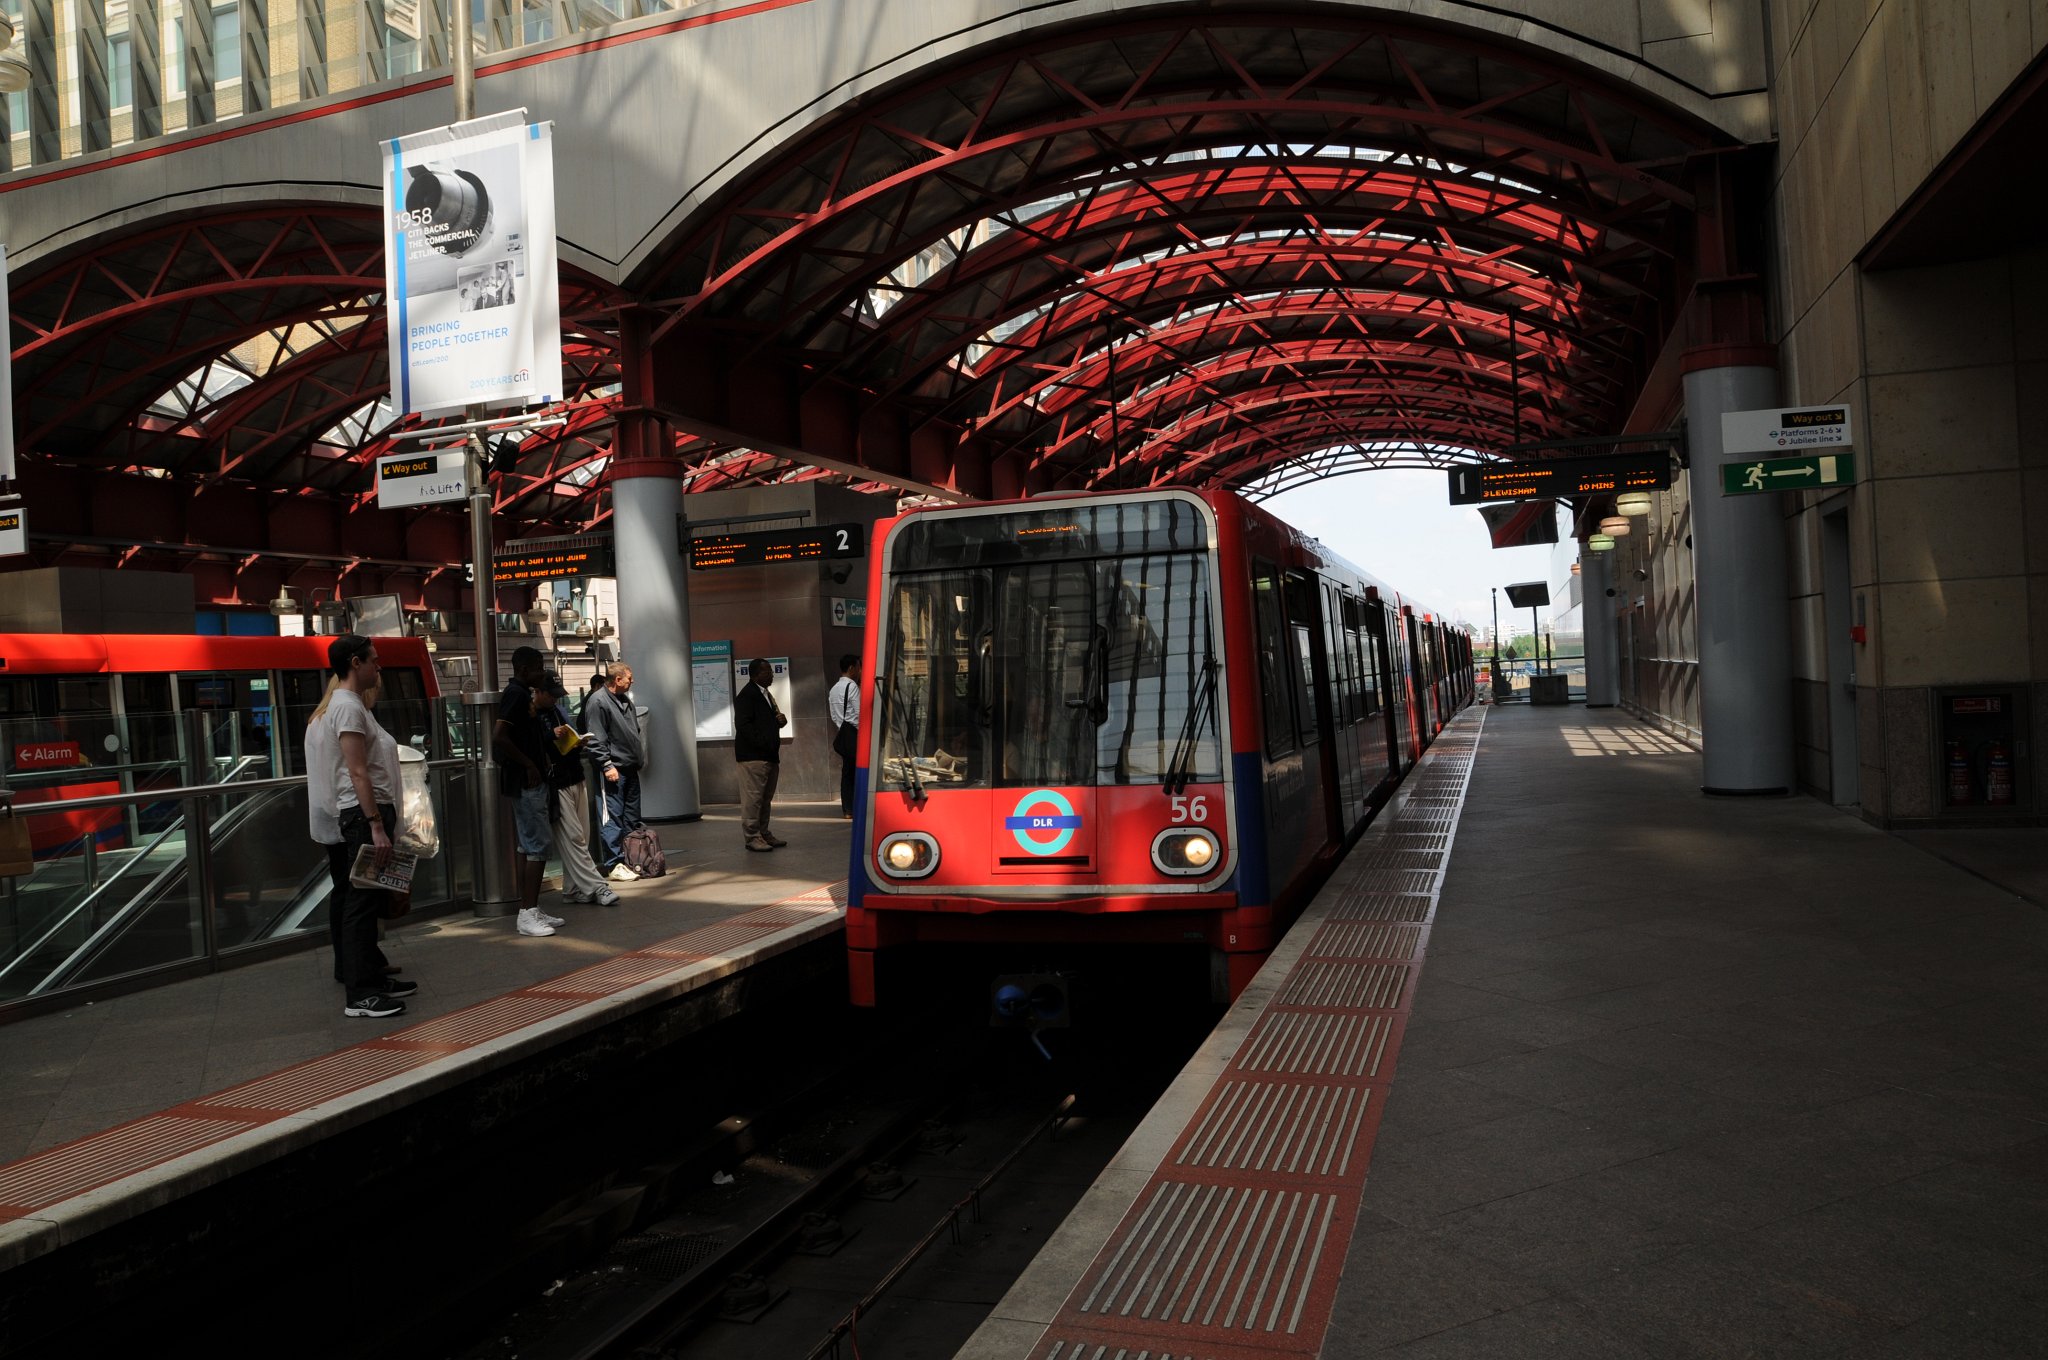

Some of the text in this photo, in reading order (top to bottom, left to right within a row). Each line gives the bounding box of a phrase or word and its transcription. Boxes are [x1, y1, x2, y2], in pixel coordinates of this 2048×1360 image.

[395, 207, 432, 230] 1958
[408, 223, 449, 238] CITI BACKS
[408, 228, 475, 248] THE COMMERCIAL
[408, 246, 448, 261] JETLINER.
[411, 320, 460, 337] BRINGING
[412, 327, 508, 352] PEOPLE TOGETHER
[514, 372, 528, 382] citi
[1792, 413, 1832, 424] Way out
[1781, 429, 1818, 437] Platforms
[392, 462, 428, 474] Way out
[438, 484, 452, 494] Lift
[1459, 472, 1466, 494] 1
[1591, 482, 1615, 490] MINS
[836, 530, 849, 550] 2
[465, 563, 474, 582] 3
[692, 644, 727, 652] Information
[34, 748, 72, 760] Alarm
[1171, 796, 1208, 822] 56
[1033, 818, 1053, 827] DLR
[380, 875, 410, 890] METRO
[1229, 935, 1236, 944] B
